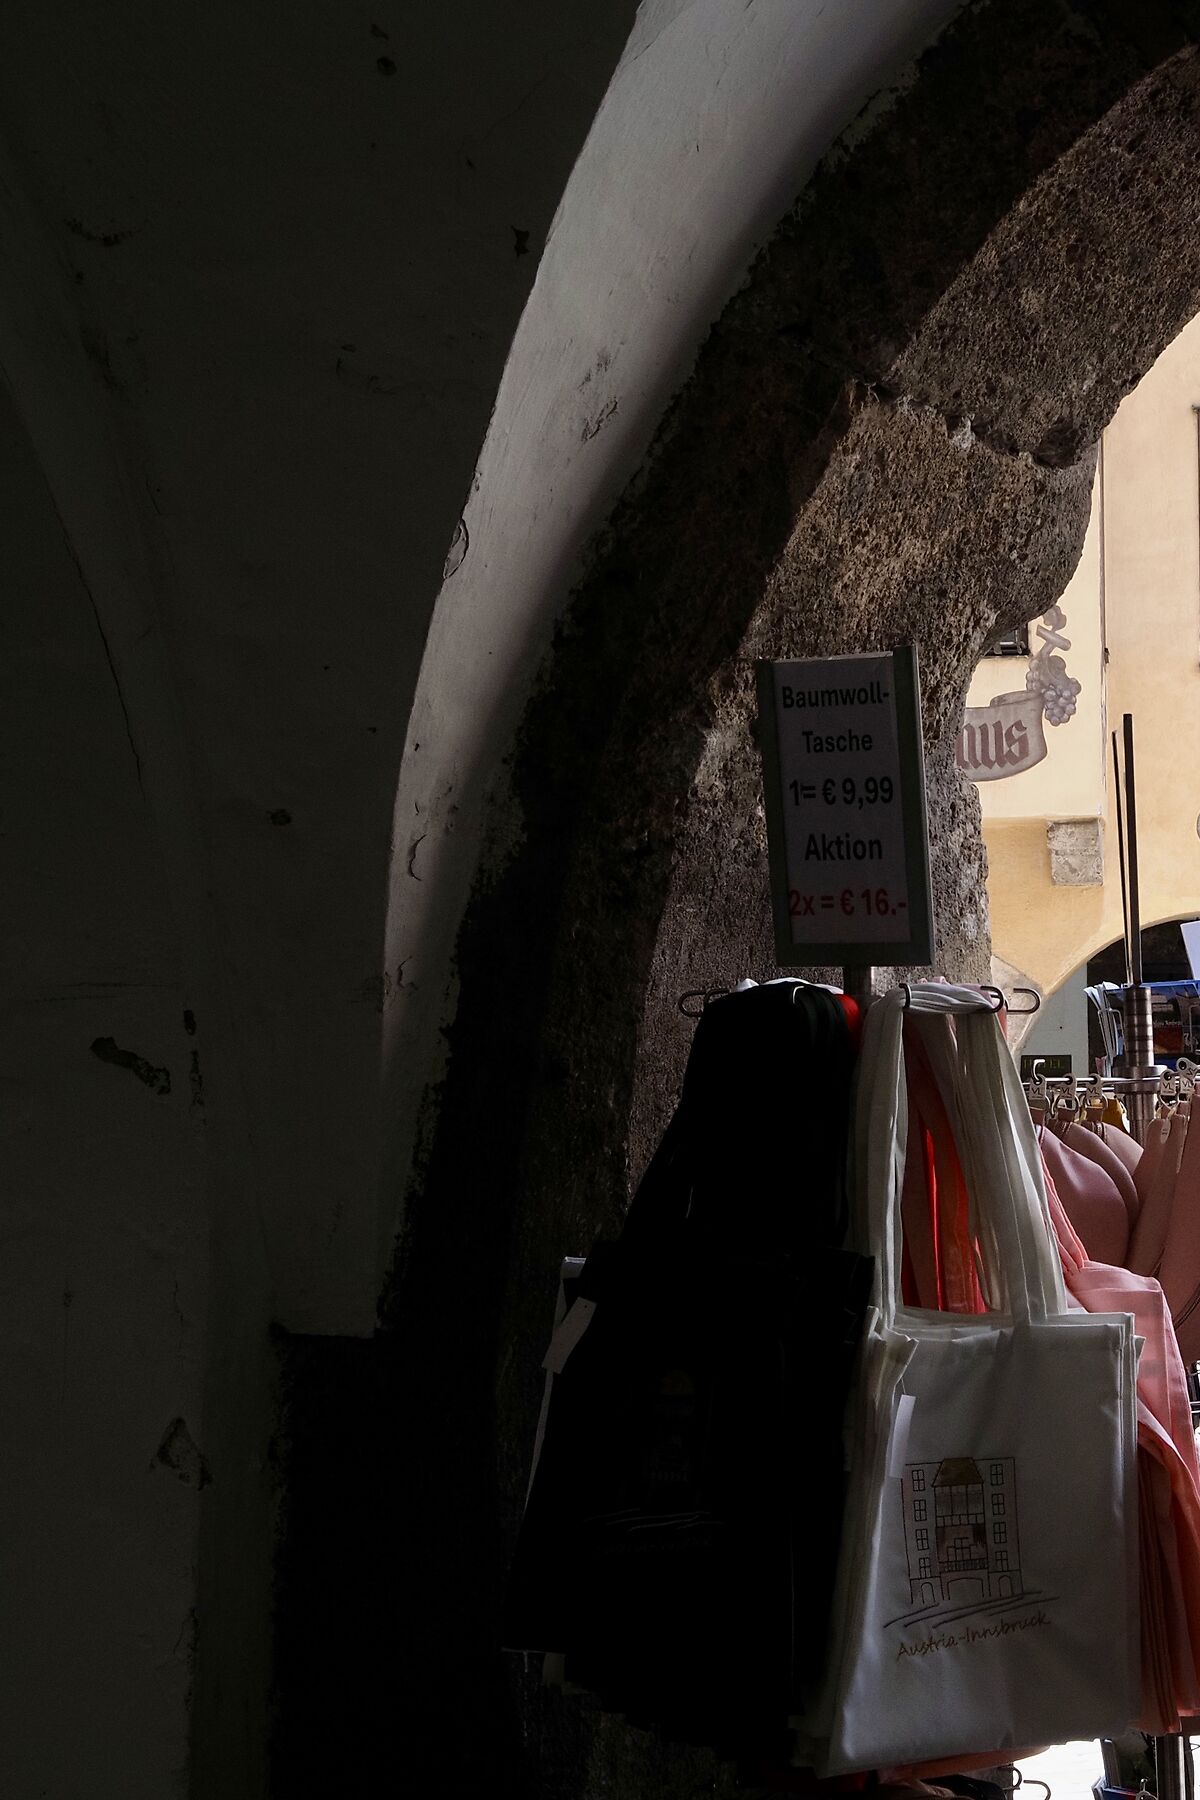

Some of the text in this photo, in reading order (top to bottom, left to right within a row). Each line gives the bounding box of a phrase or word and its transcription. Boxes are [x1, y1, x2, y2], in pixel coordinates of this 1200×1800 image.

[782, 681, 889, 709] Baumwoll-
[802, 729, 873, 754] Tasche
[804, 832, 883, 861] Aktion
[896, 1610, 1051, 1662] Austria-Innsbruck
